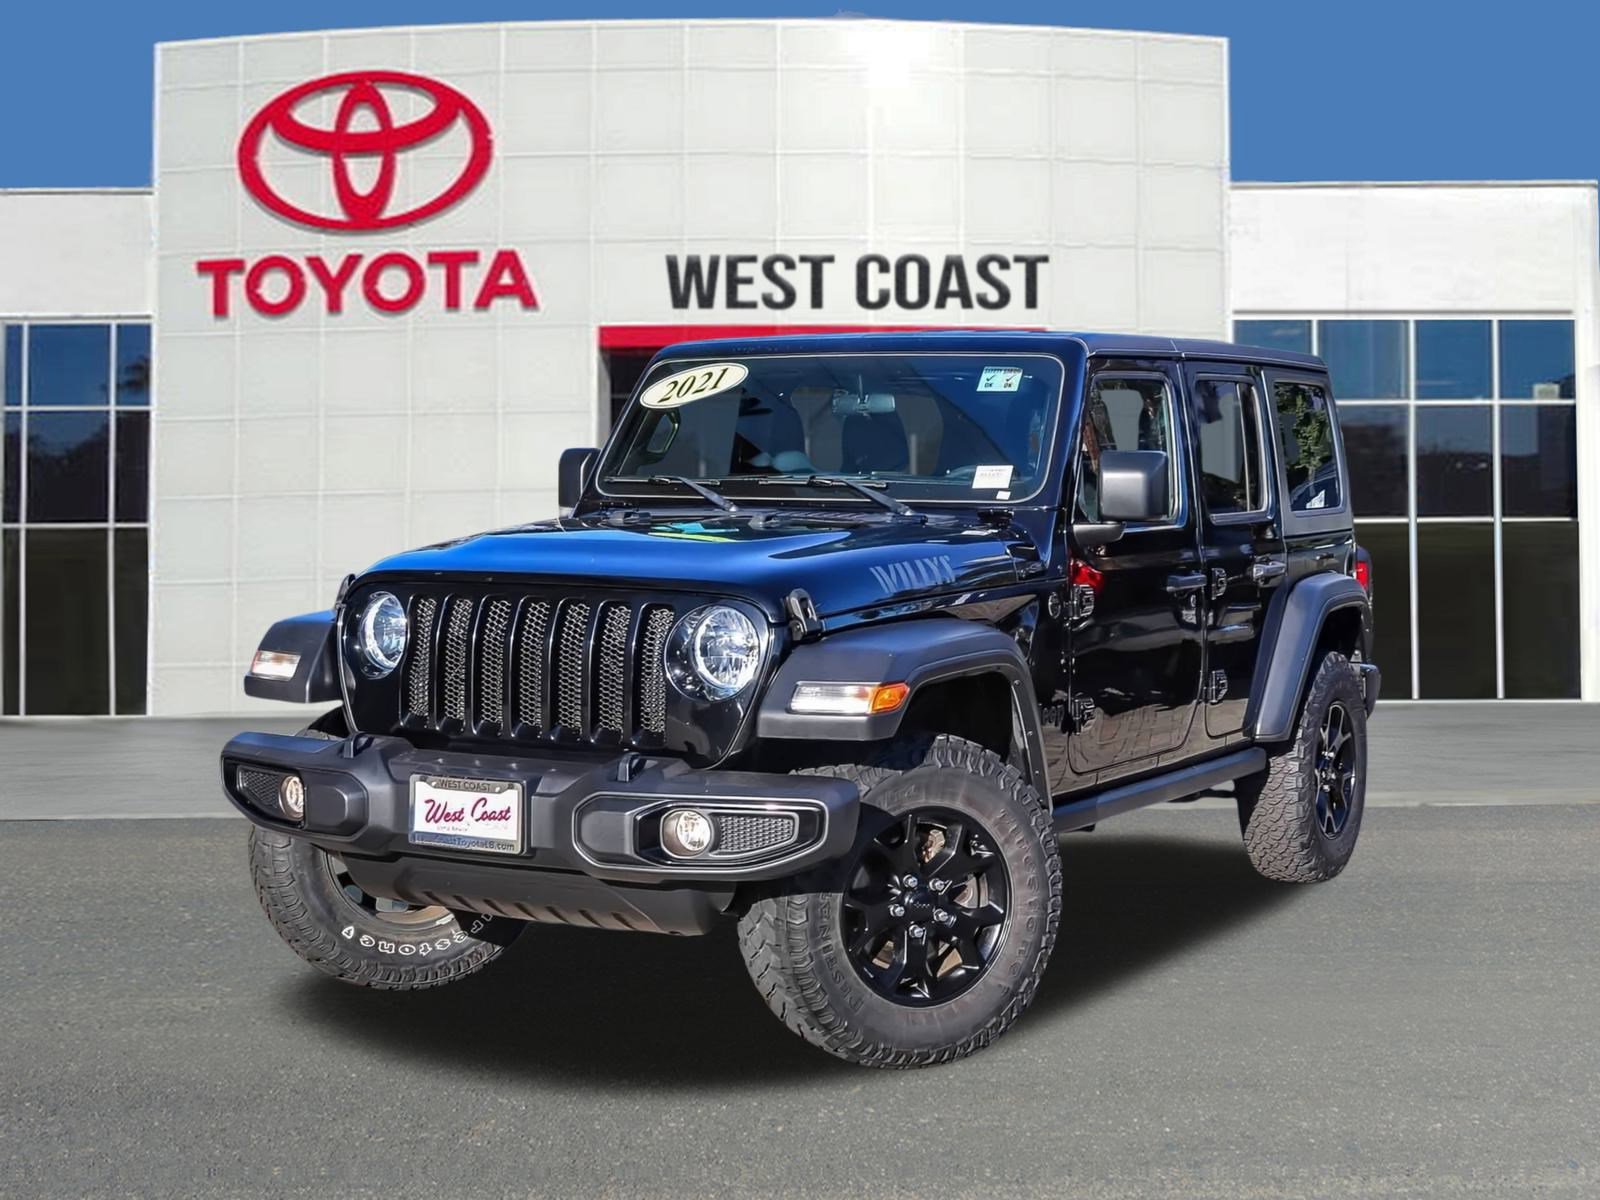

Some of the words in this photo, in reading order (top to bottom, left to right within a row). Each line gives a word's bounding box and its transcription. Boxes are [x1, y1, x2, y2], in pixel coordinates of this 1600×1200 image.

[196, 248, 539, 318] TOYOTA
[665, 253, 836, 311] WEST
[855, 253, 1050, 311] COAST
[656, 367, 729, 404] 2021
[869, 554, 956, 595] WILLYS
[439, 780, 462, 789] WEST
[464, 782, 491, 791] COAST
[424, 798, 465, 824] West
[471, 797, 511, 822] Coast
